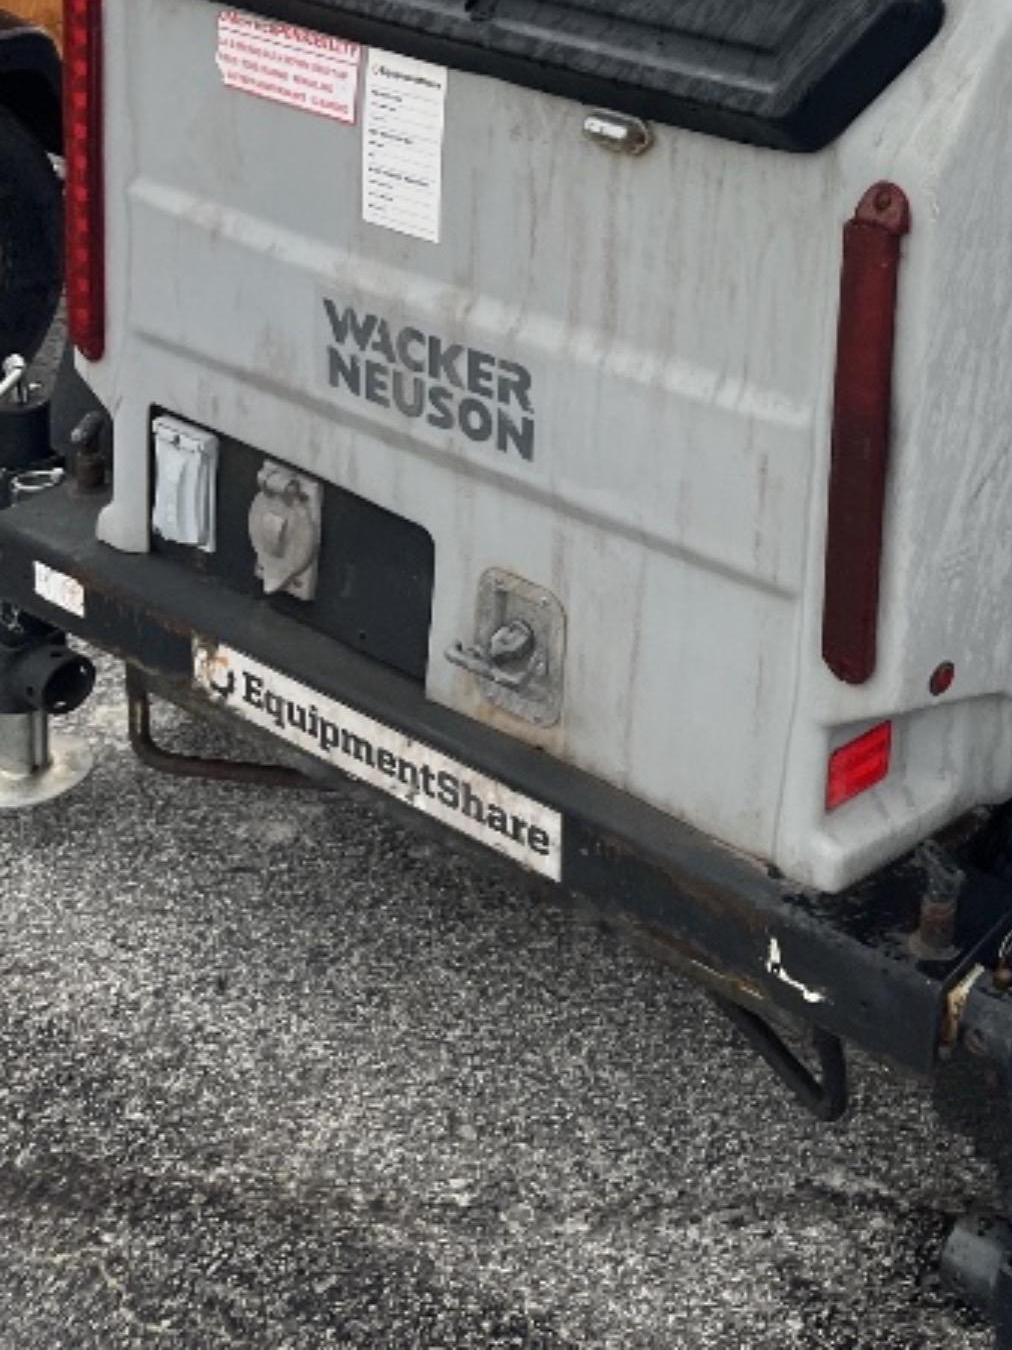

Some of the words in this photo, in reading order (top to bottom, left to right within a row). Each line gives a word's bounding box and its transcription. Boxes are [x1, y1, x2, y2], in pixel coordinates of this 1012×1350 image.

[323, 297, 534, 414] WACKER
[327, 345, 534, 462] NEUSON
[242, 670, 550, 855] EquipmentShare
